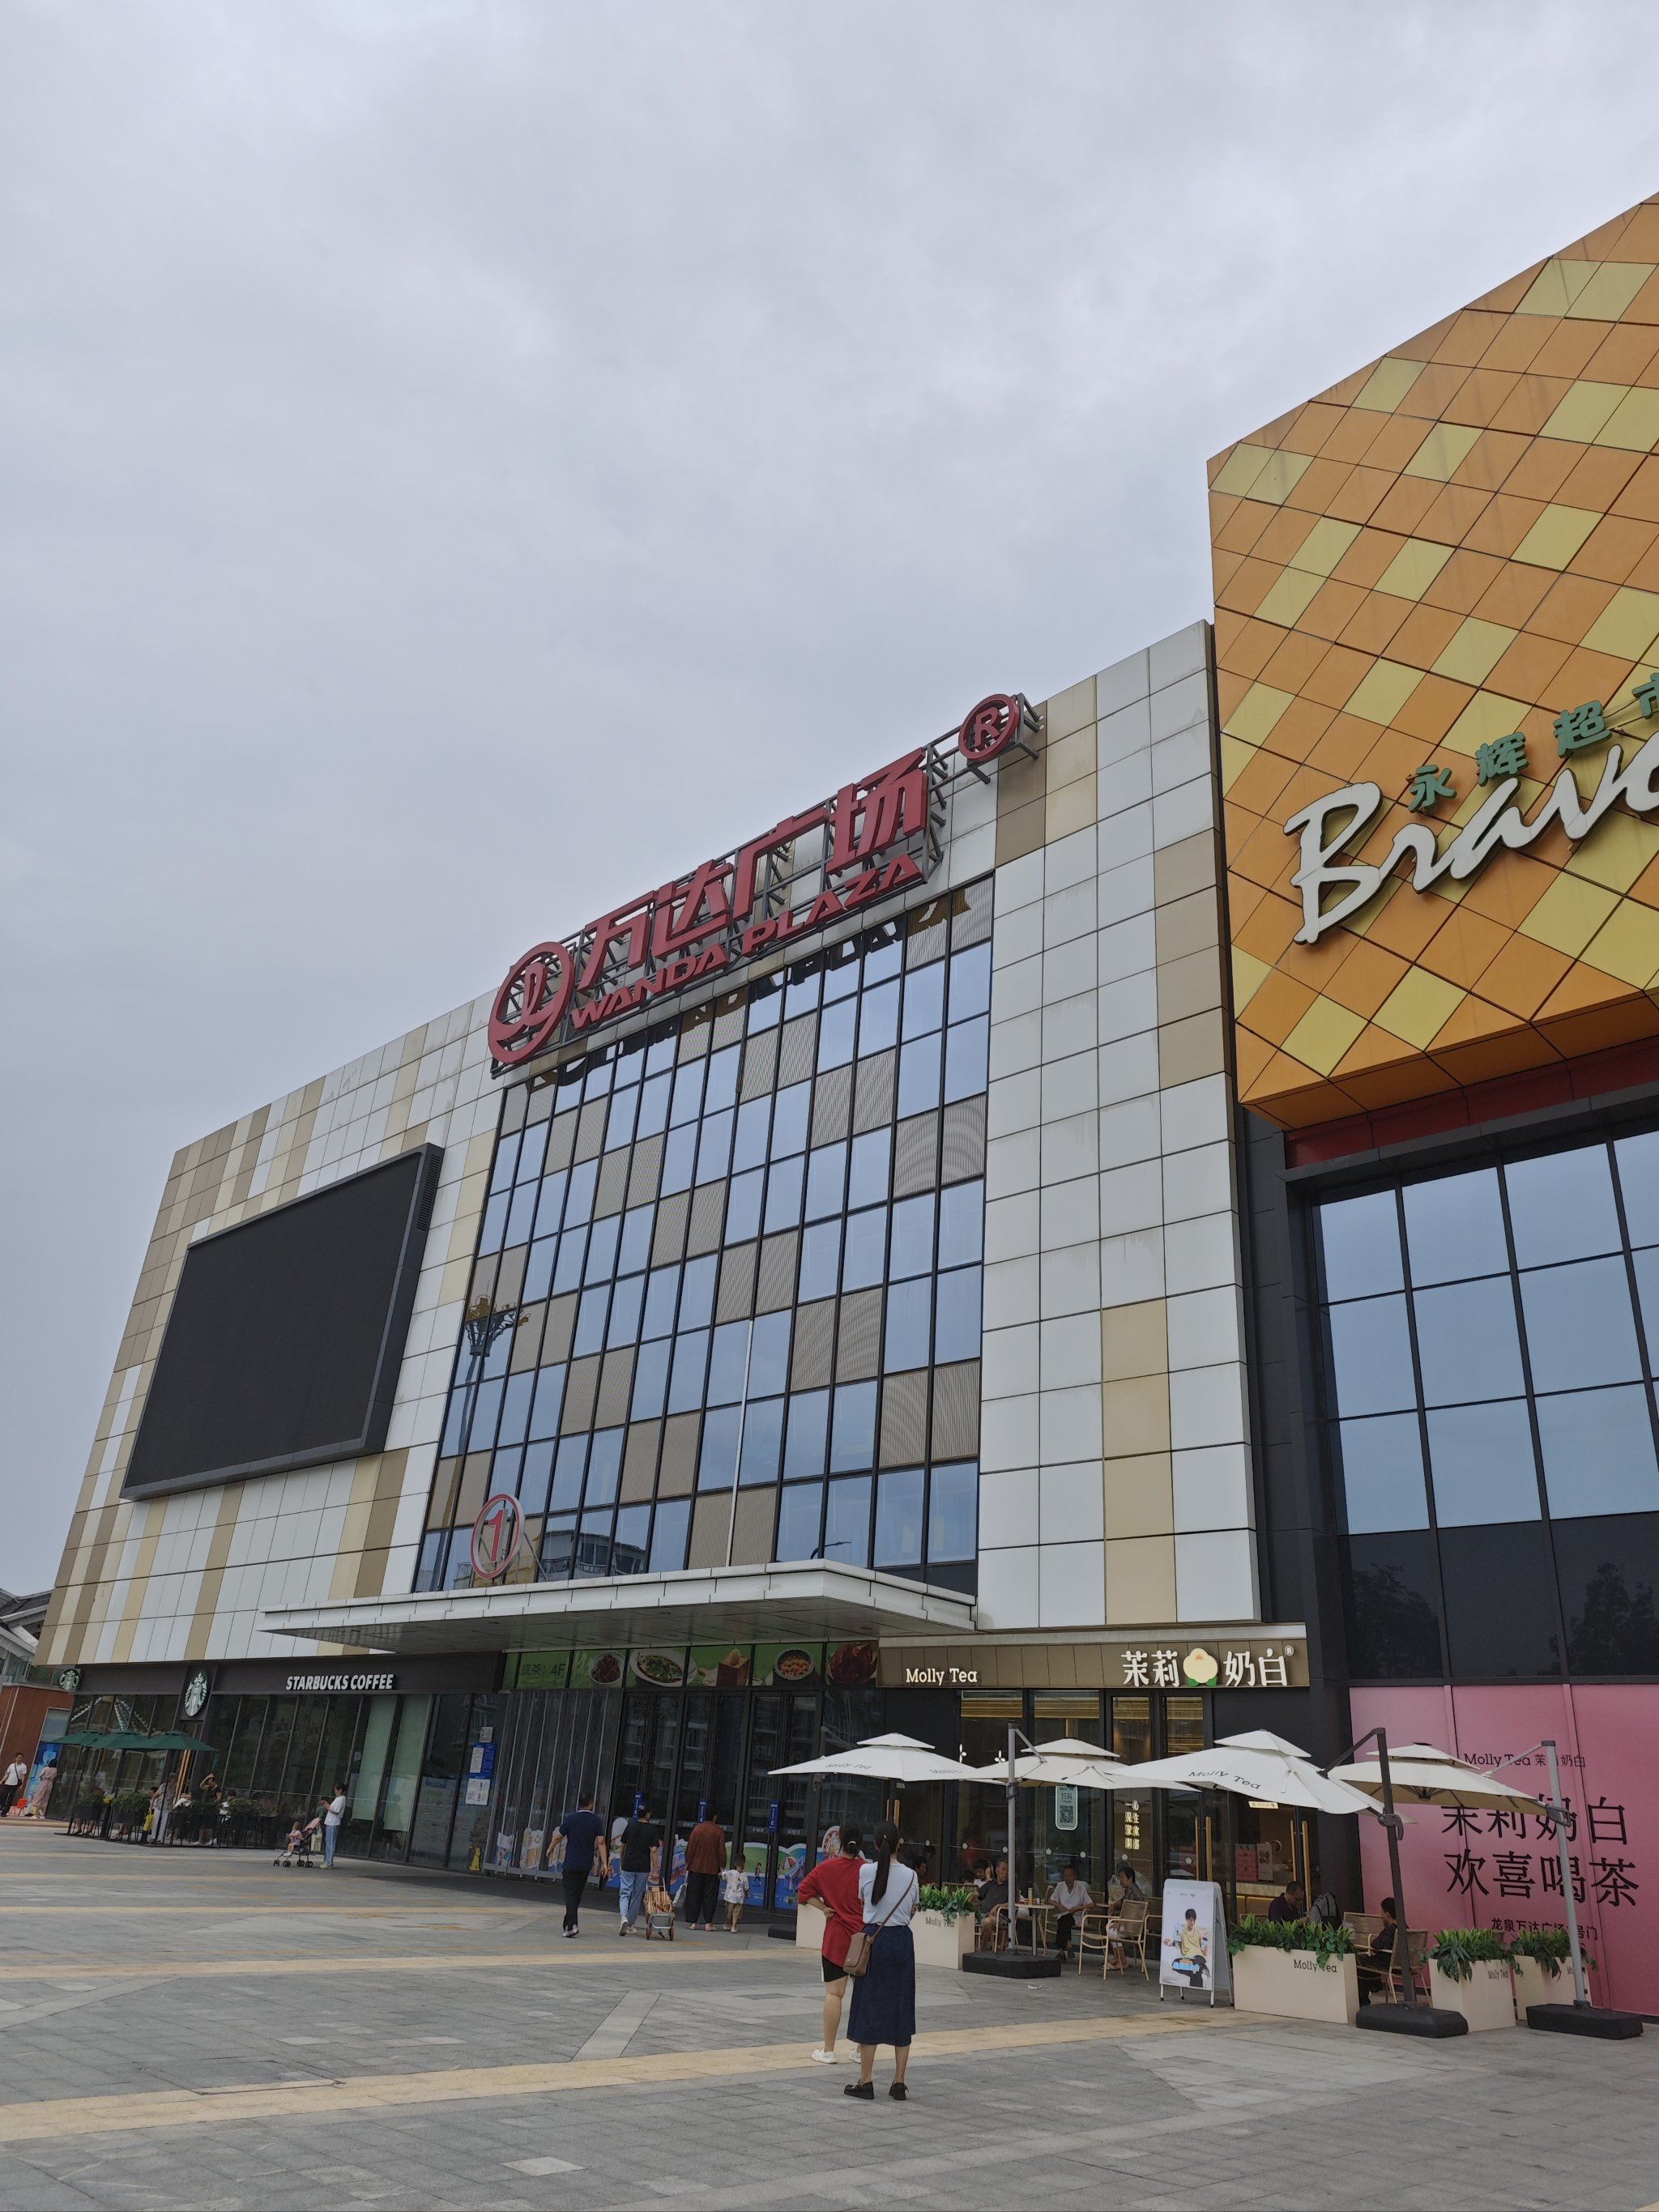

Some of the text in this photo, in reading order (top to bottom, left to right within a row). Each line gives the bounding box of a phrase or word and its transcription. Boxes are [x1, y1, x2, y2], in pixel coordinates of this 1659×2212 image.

[578, 748, 928, 993] 万达广场
[571, 853, 923, 1029] WANDA PLAZA
[551, 1663, 565, 1677] 4F
[906, 1668, 978, 1686] Molly Tea
[286, 1673, 394, 1691] STARBUCKS COFFEE
[1464, 1754, 1502, 1767] Molly
[1534, 1754, 1586, 1767] 茉奶白
[1233, 1775, 1261, 1790] Tea
[1444, 1848, 1640, 1907] 欢喜喝茶
[925, 1916, 942, 1928] Molly
[1294, 1958, 1317, 1973] Molly
